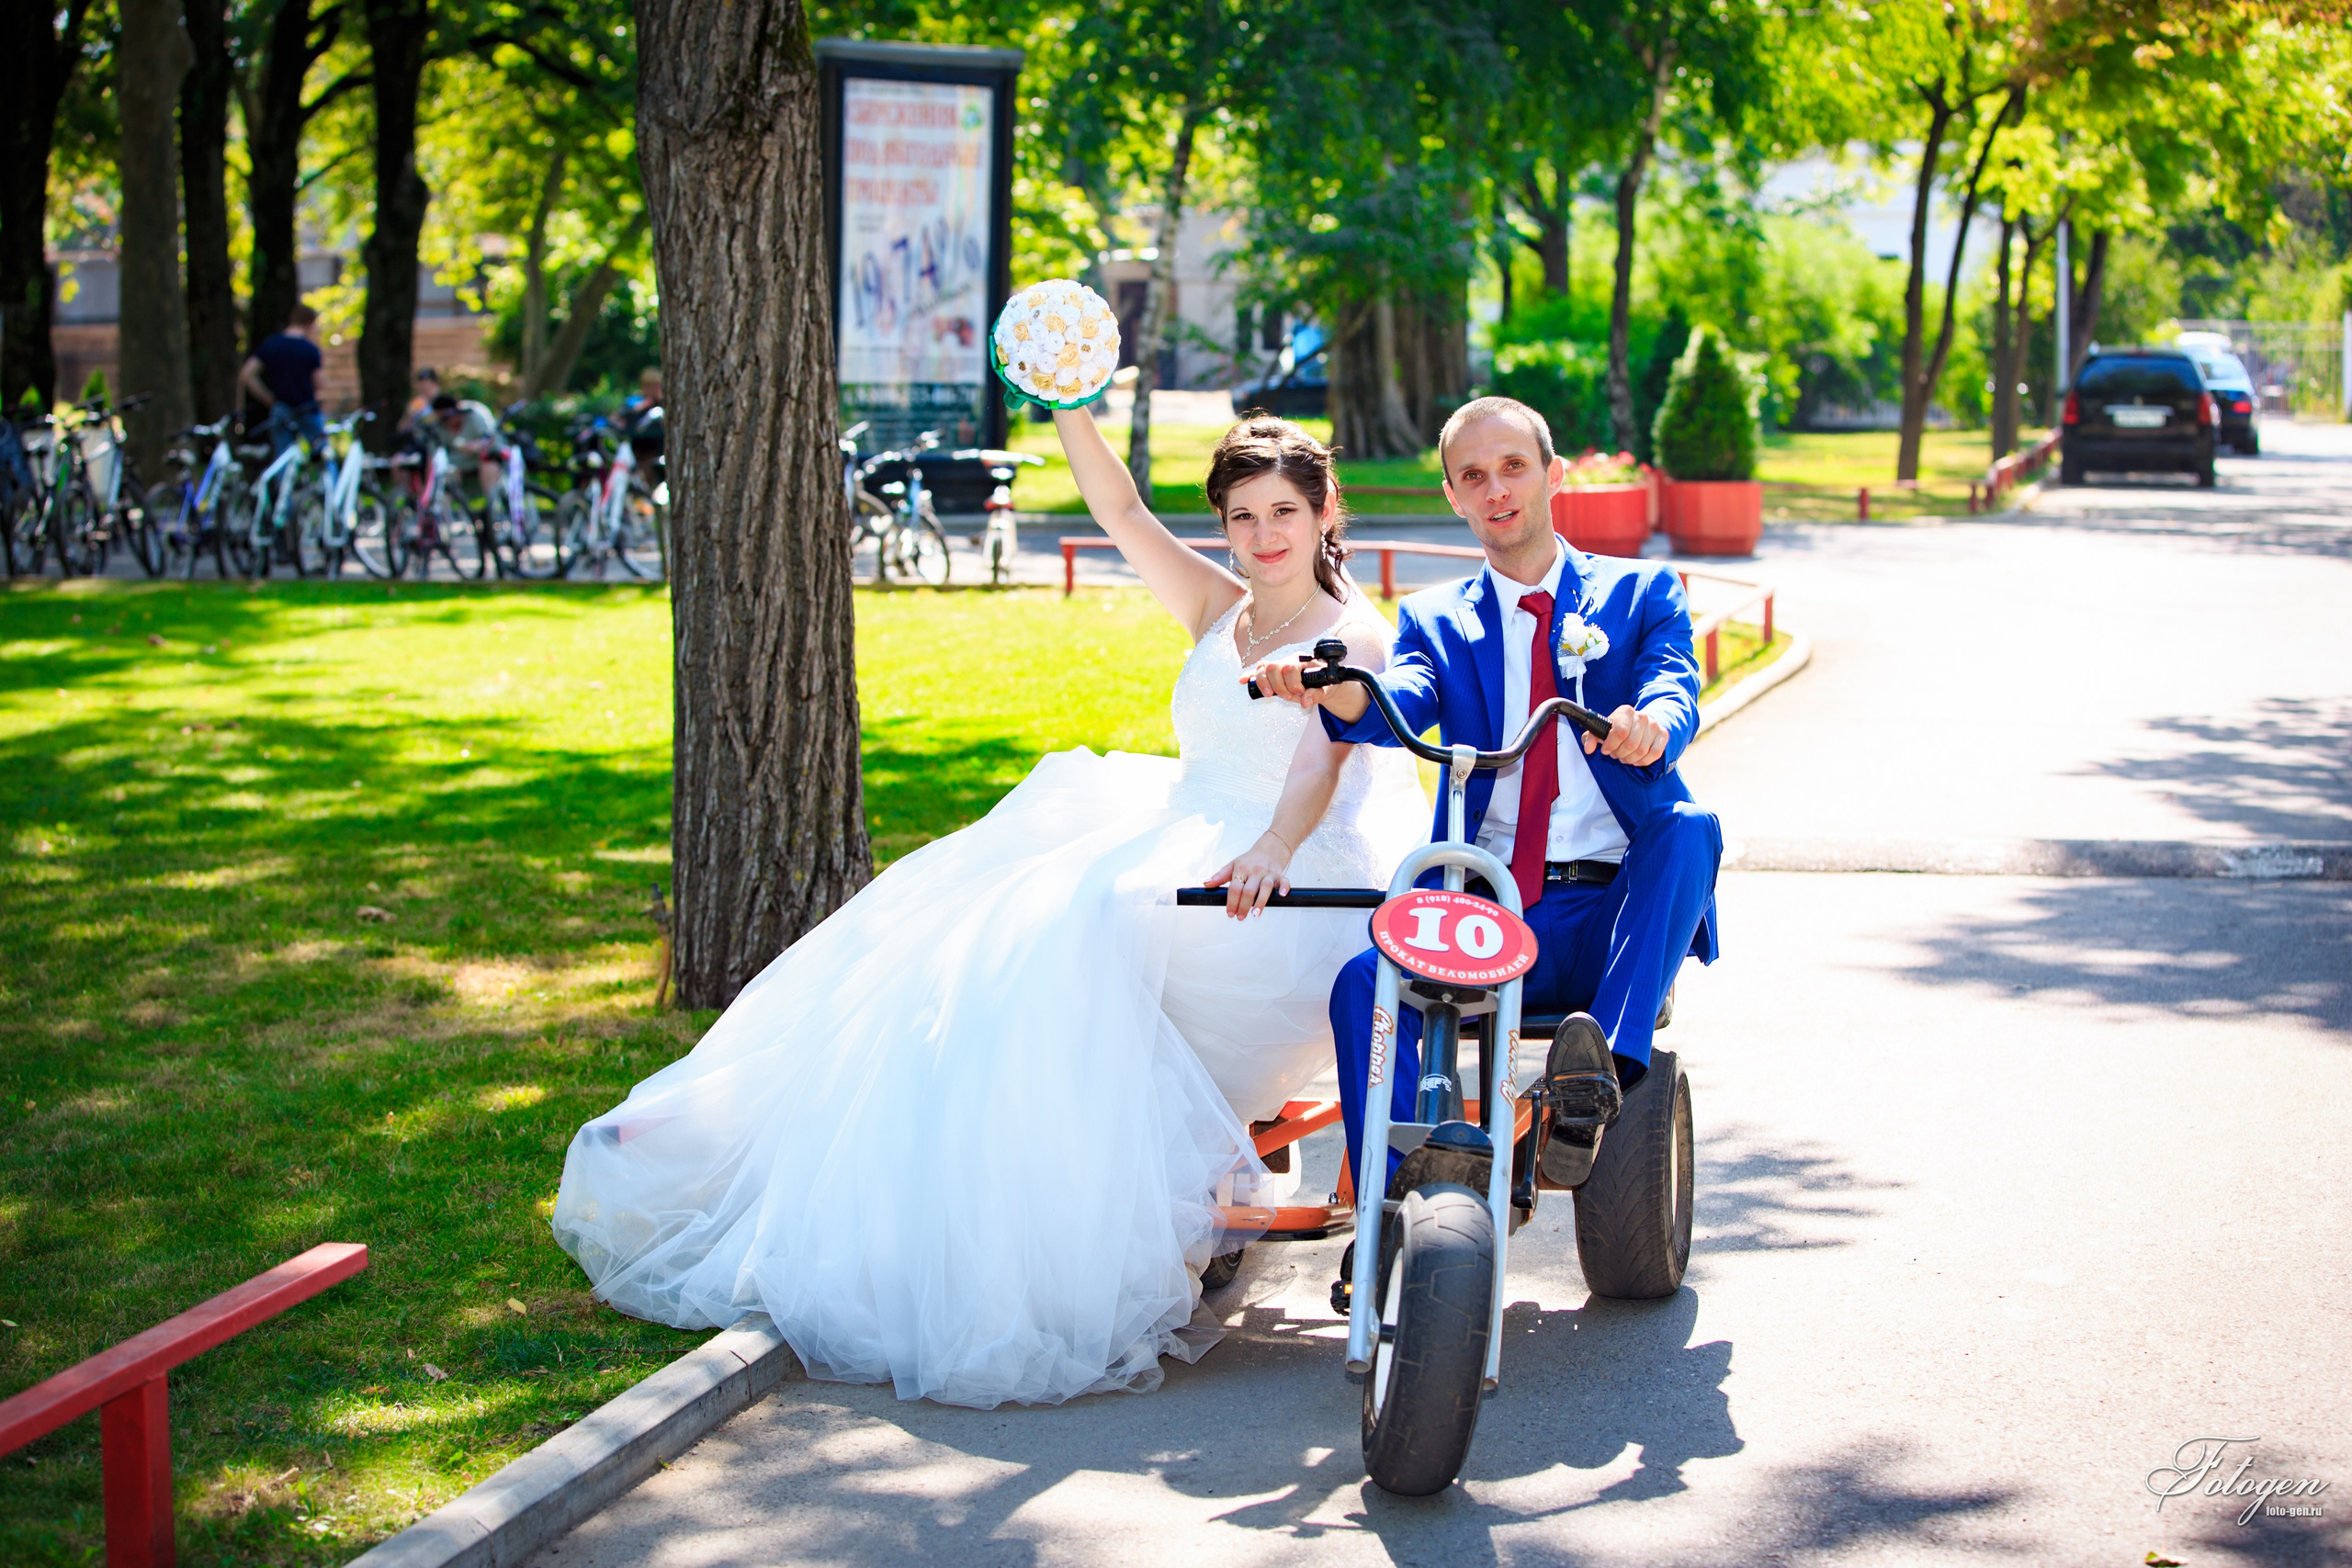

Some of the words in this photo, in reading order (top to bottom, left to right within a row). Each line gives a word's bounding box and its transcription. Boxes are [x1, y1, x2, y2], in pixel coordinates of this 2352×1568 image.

[1425, 895, 1451, 904] (918)
[1453, 897, 1499, 917] 480-24-90
[1379, 931, 1426, 969] ПРОКАТ
[1428, 953, 1530, 980] ВЕЛОМОБИЛЕЙ
[1404, 907, 1504, 959] 10
